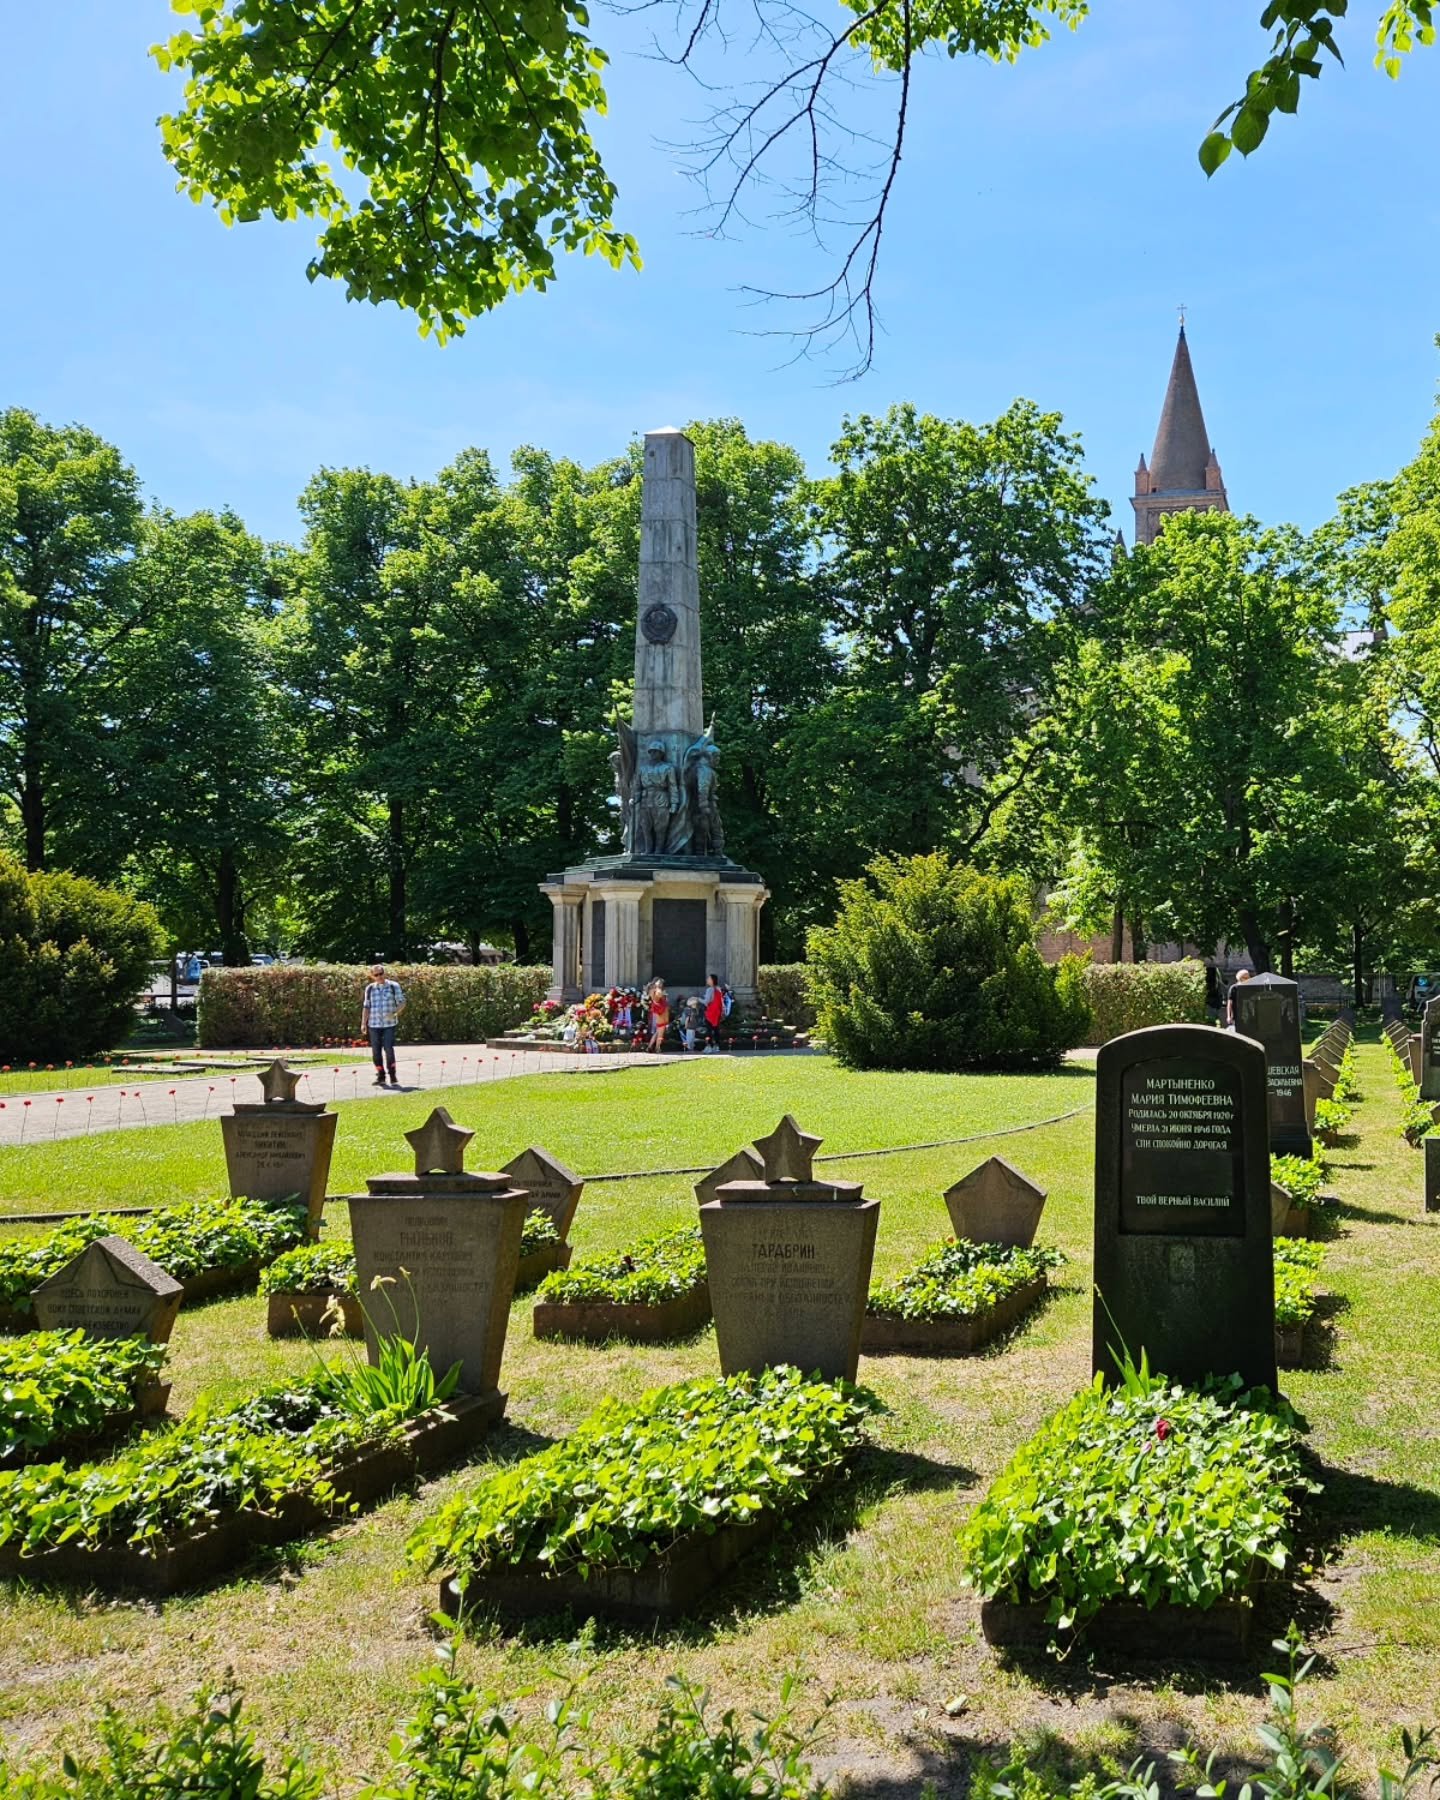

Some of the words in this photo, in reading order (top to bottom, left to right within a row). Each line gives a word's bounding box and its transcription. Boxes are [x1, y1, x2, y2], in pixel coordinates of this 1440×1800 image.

[1146, 1078, 1215, 1089] МАРТЫНЕНКО
[1276, 1088, 1292, 1097] 1946
[1131, 1093, 1165, 1105] МАРИЯ
[1167, 1094, 1233, 1106] ТИМОФЕЕВНА
[1128, 1108, 1167, 1119] РОДИЛАСЬ
[1168, 1110, 1178, 1119] 20
[1179, 1110, 1212, 1120] ОКТЯБРЯ
[1131, 1122, 1160, 1133] УМЕРЛА
[1169, 1124, 1192, 1133] ИЮНЯ
[1211, 1125, 1231, 1134] ГОДА
[1135, 1139, 1151, 1148] СПИ
[1152, 1137, 1191, 1149] СПОКОЙНО
[1193, 1140, 1227, 1150] ДОРОГАЯ
[1136, 1194, 1157, 1206] ТВОЙ
[1158, 1194, 1191, 1206] ВЕРНЫЙ
[1193, 1195, 1230, 1207] ВАСИЛИЙ
[752, 1243, 815, 1259] ТАРАБРИН
